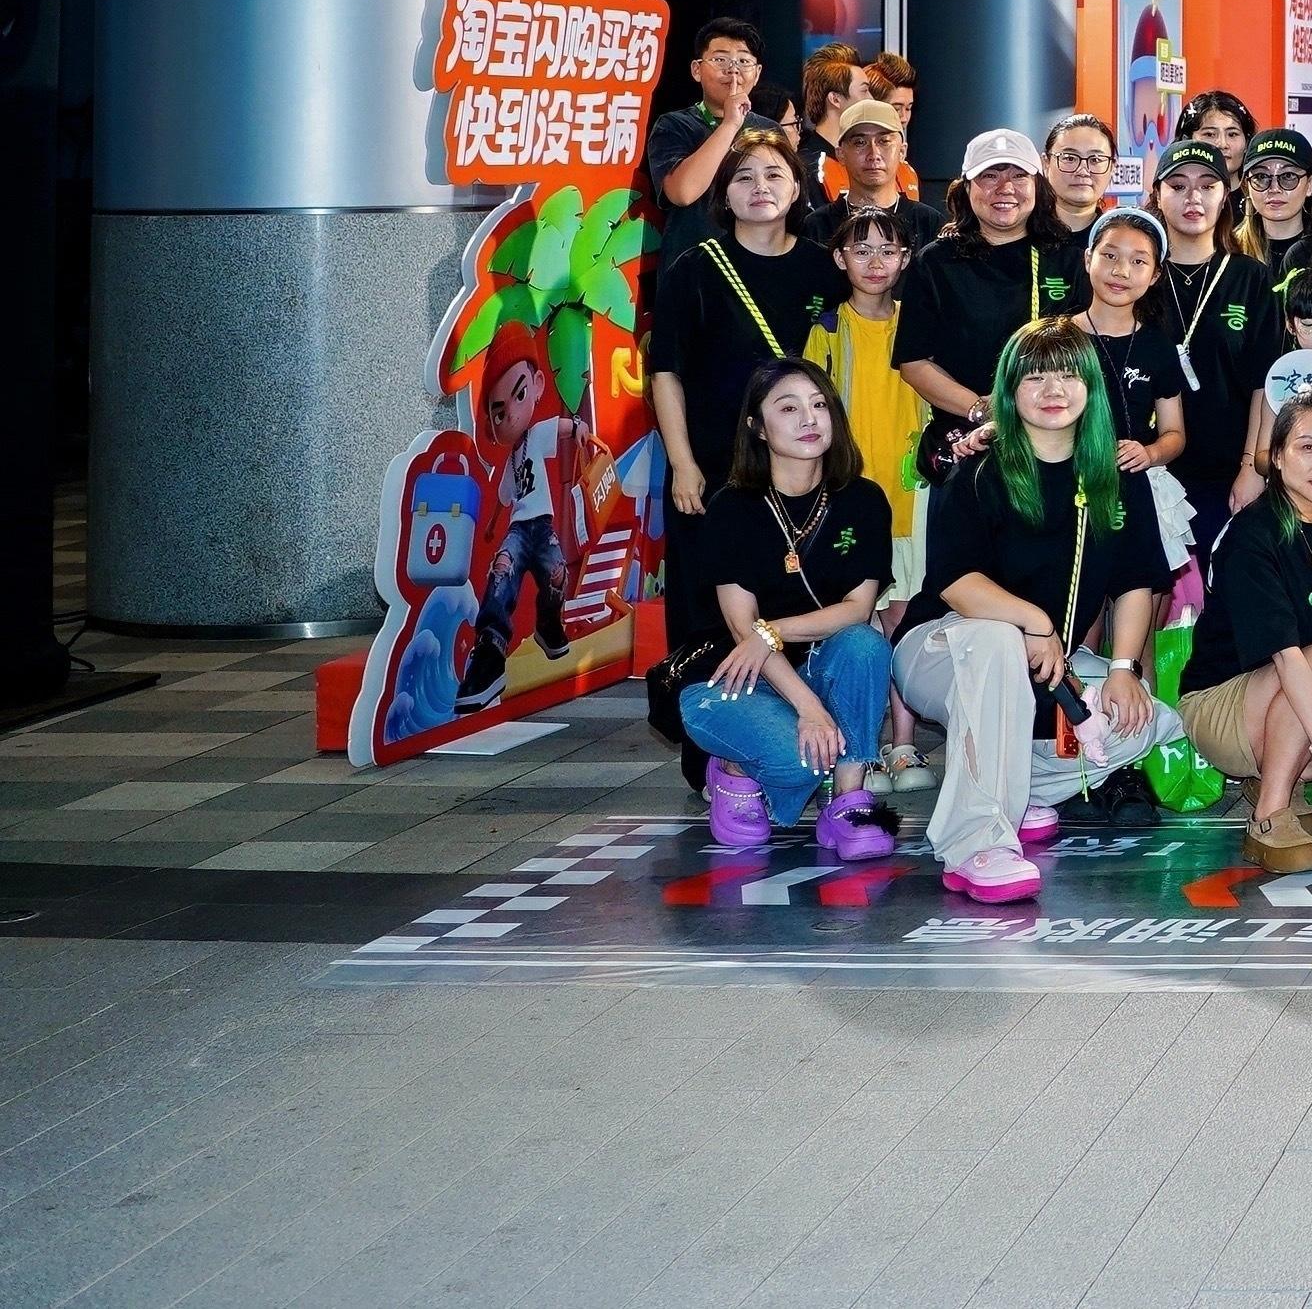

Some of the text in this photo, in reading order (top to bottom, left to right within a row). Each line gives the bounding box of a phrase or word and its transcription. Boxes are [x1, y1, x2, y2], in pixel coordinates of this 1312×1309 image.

[453, 87, 644, 168] 快到没毛病
[1257, 140, 1296, 154] BIG MAN
[1172, 148, 1214, 163] BIG MAN
